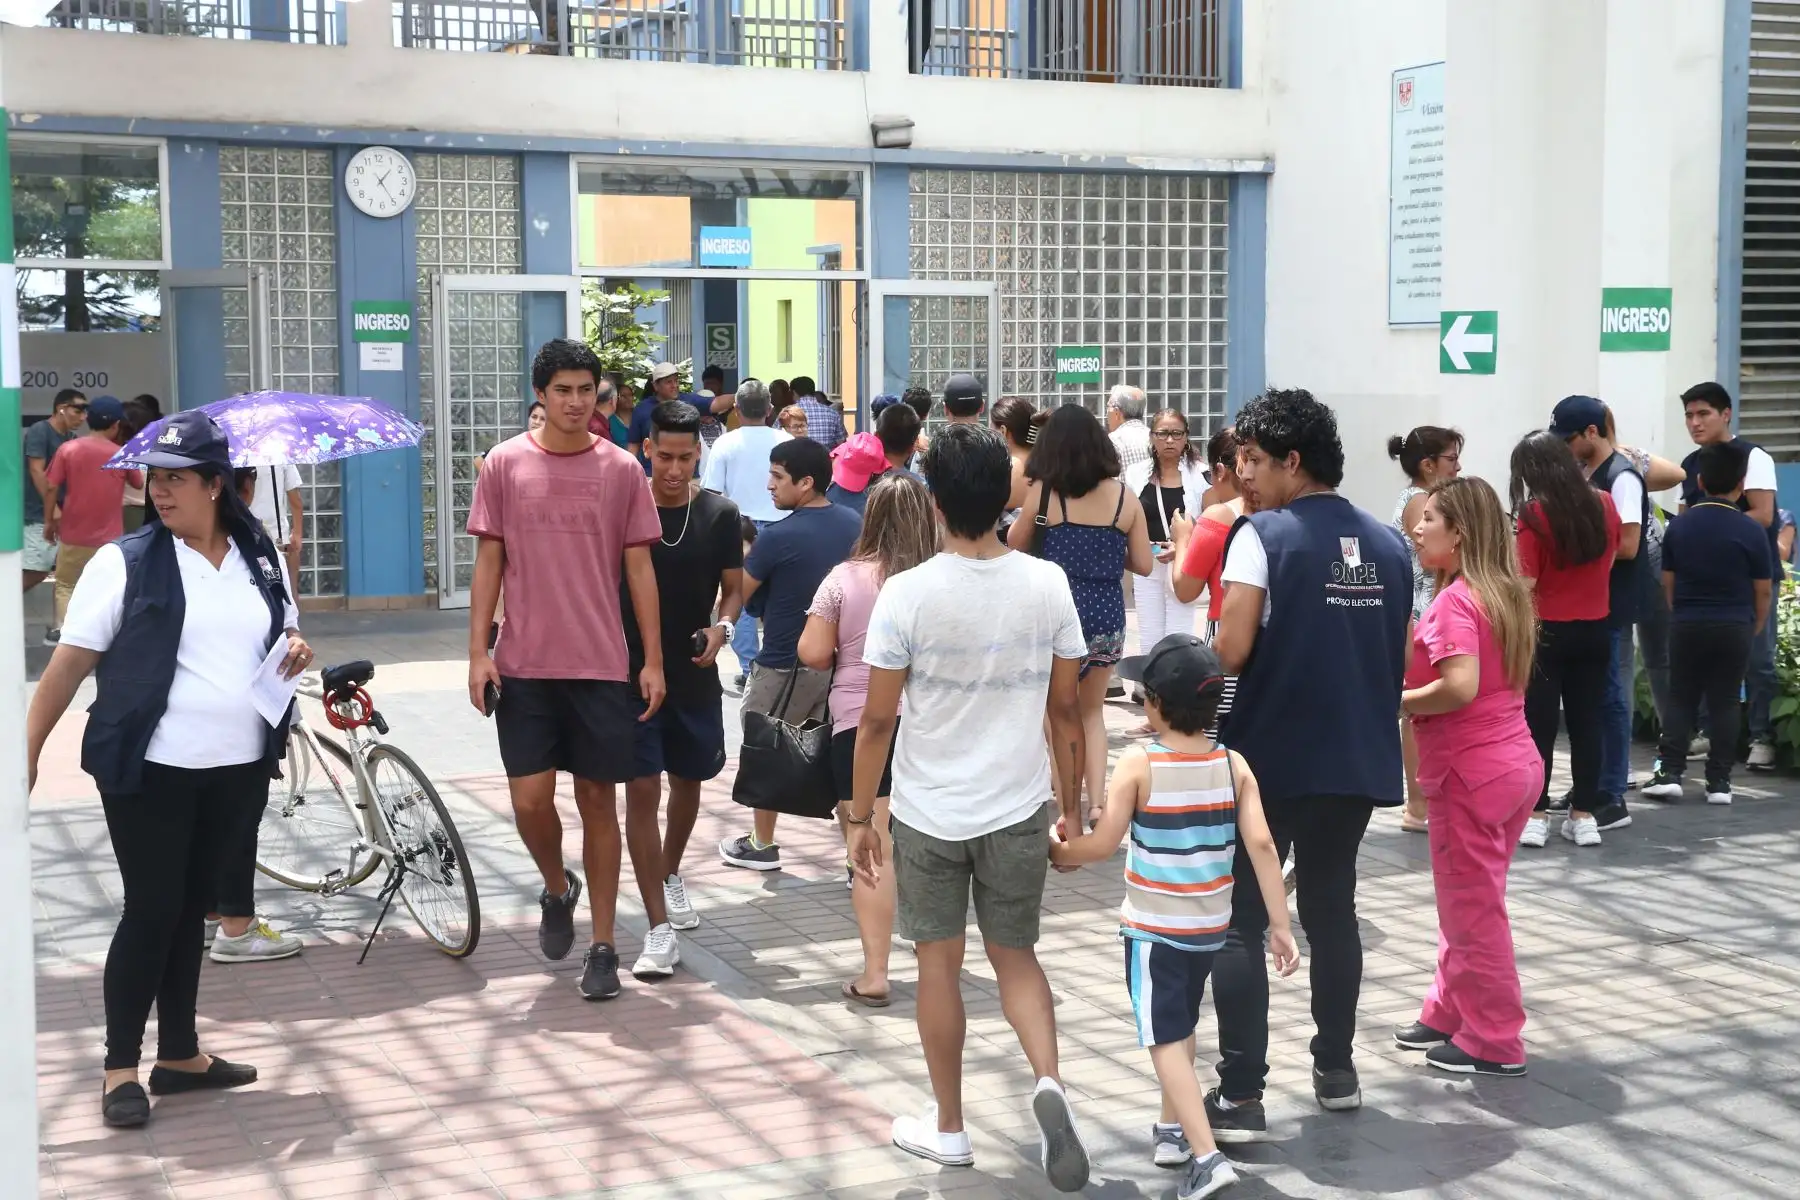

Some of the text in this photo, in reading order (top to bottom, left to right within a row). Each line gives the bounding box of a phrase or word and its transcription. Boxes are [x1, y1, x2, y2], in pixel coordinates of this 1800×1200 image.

[701, 238, 751, 254] INGRESO
[354, 313, 410, 331] INGRESO
[1602, 306, 1671, 333] INGRESO
[711, 326, 732, 351] S
[1056, 357, 1100, 373] INGRESO
[22, 371, 108, 388] 200 300
[1331, 562, 1377, 583] ONPE
